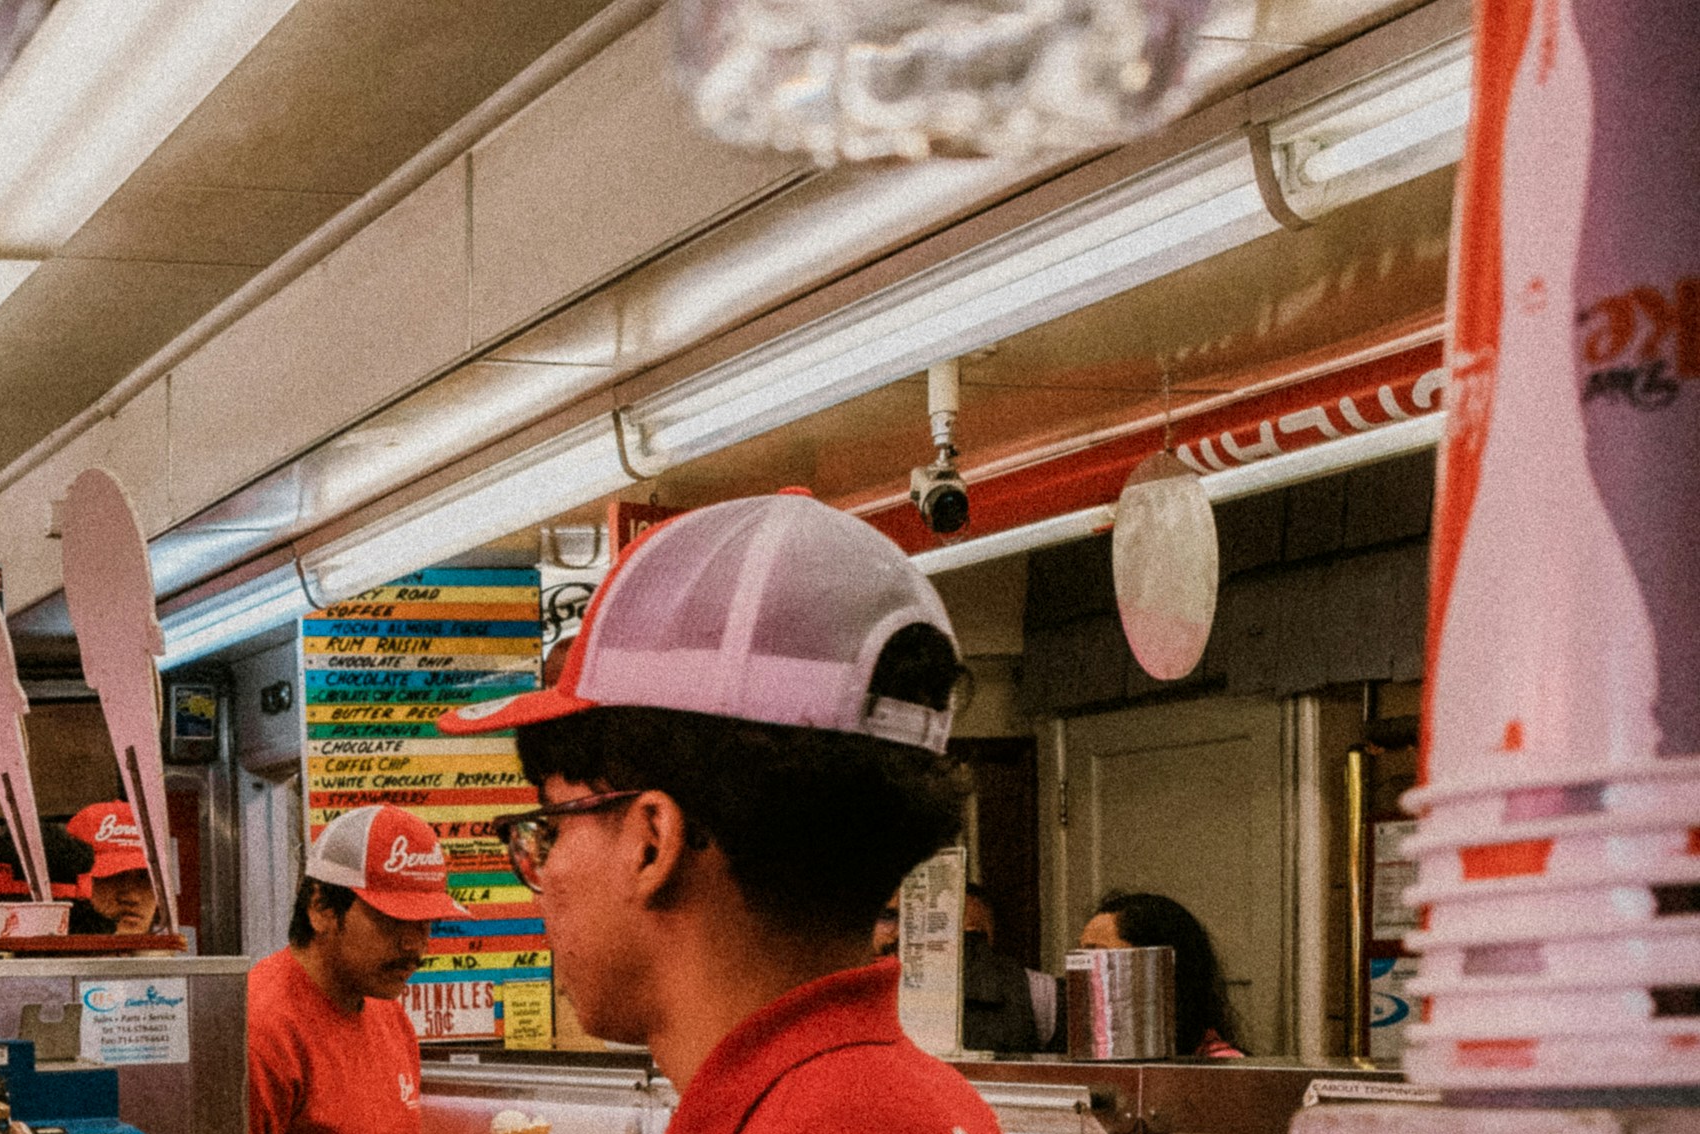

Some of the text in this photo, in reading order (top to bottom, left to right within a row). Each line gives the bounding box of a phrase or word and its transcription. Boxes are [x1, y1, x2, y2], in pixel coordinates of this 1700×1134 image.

[396, 588, 440, 600] ROAD
[330, 623, 379, 635] MOCHA
[327, 638, 432, 651] RUM RAISIN
[329, 656, 452, 668] CHOCOLATE CHIP
[326, 673, 409, 685] CHOCOLATE
[332, 707, 394, 719] BUTTER
[321, 741, 404, 754] CHOCOLATE
[325, 758, 410, 772] COFFEE CHIP
[322, 775, 364, 788] WHITE
[372, 774, 443, 787] CHOCOLATE
[400, 983, 493, 1011] PRINKLES
[1322, 1083, 1359, 1093] ABOUT
